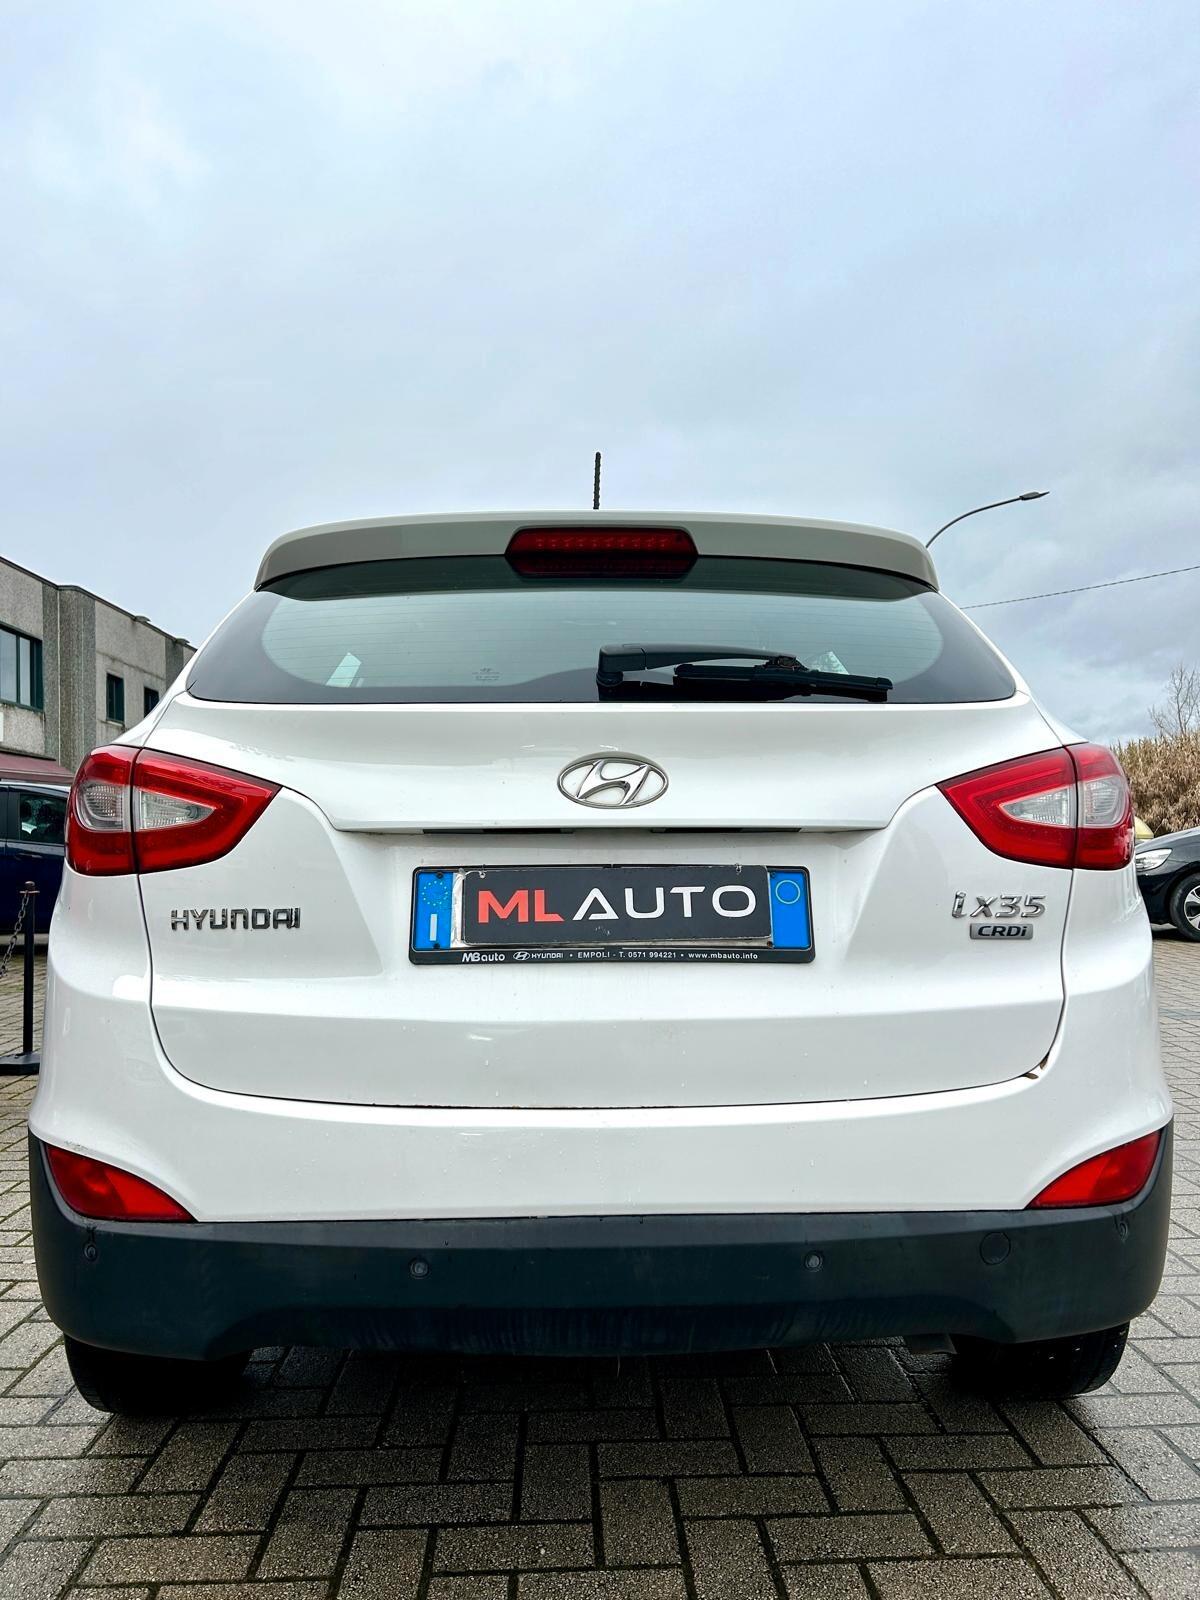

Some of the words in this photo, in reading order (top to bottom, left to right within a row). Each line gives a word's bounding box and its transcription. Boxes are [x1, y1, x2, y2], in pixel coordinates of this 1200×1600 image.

[951, 890, 1046, 919] ix35
[171, 907, 301, 930] HYUNDAI
[977, 925, 1028, 937] CRDi
[531, 951, 564, 960] HYUNDAI
[577, 951, 610, 959] EMPOLI
[619, 951, 626, 959] T.
[627, 951, 647, 959] 0571
[649, 951, 677, 959] 994221
[688, 952, 758, 960] www.mbauto.info
